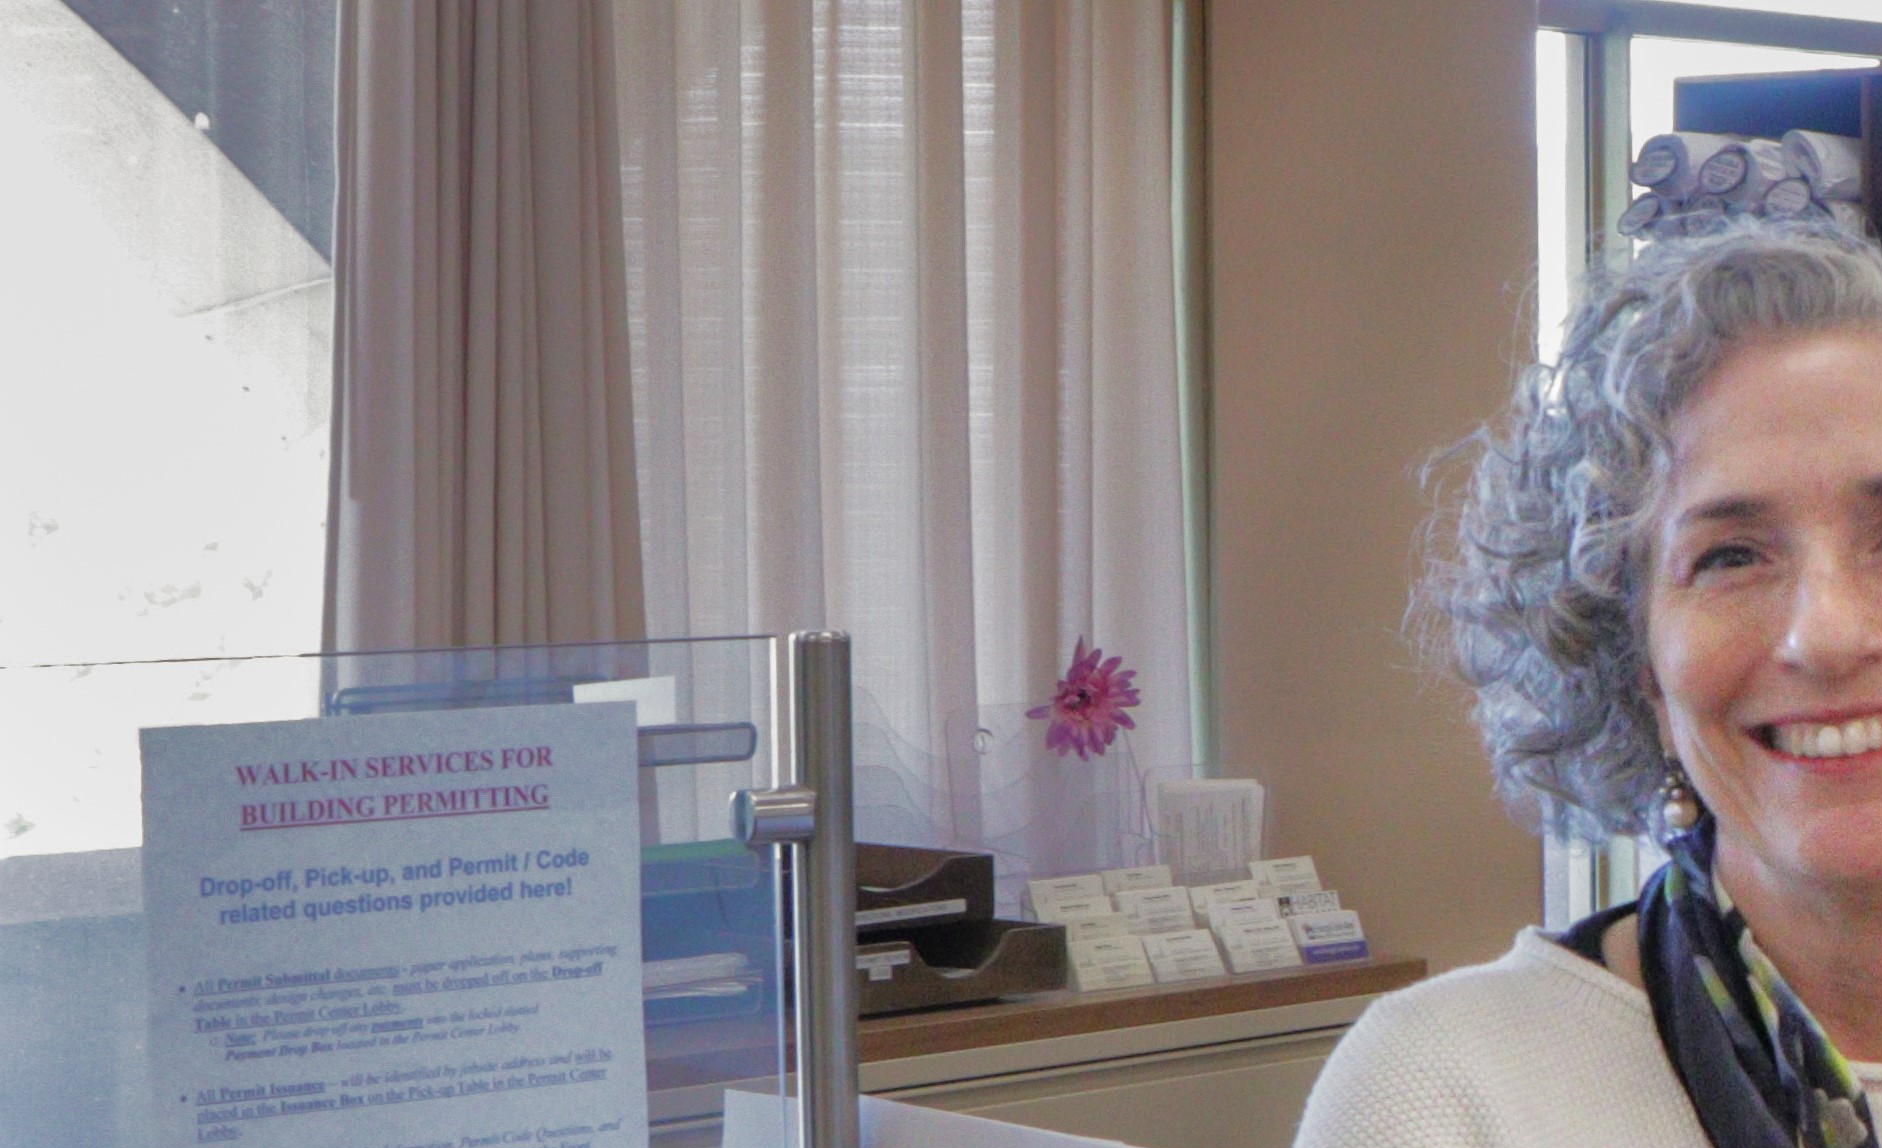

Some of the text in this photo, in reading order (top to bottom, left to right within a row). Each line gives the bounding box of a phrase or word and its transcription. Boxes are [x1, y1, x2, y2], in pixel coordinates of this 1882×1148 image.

[235, 745, 553, 787] WALK-IN SERVICES FOR
[239, 783, 549, 826] BUILDING PERMITTING
[199, 846, 589, 900] Drop-off, Pick-up, and Permit / Code
[219, 876, 572, 925] related questions provided here!
